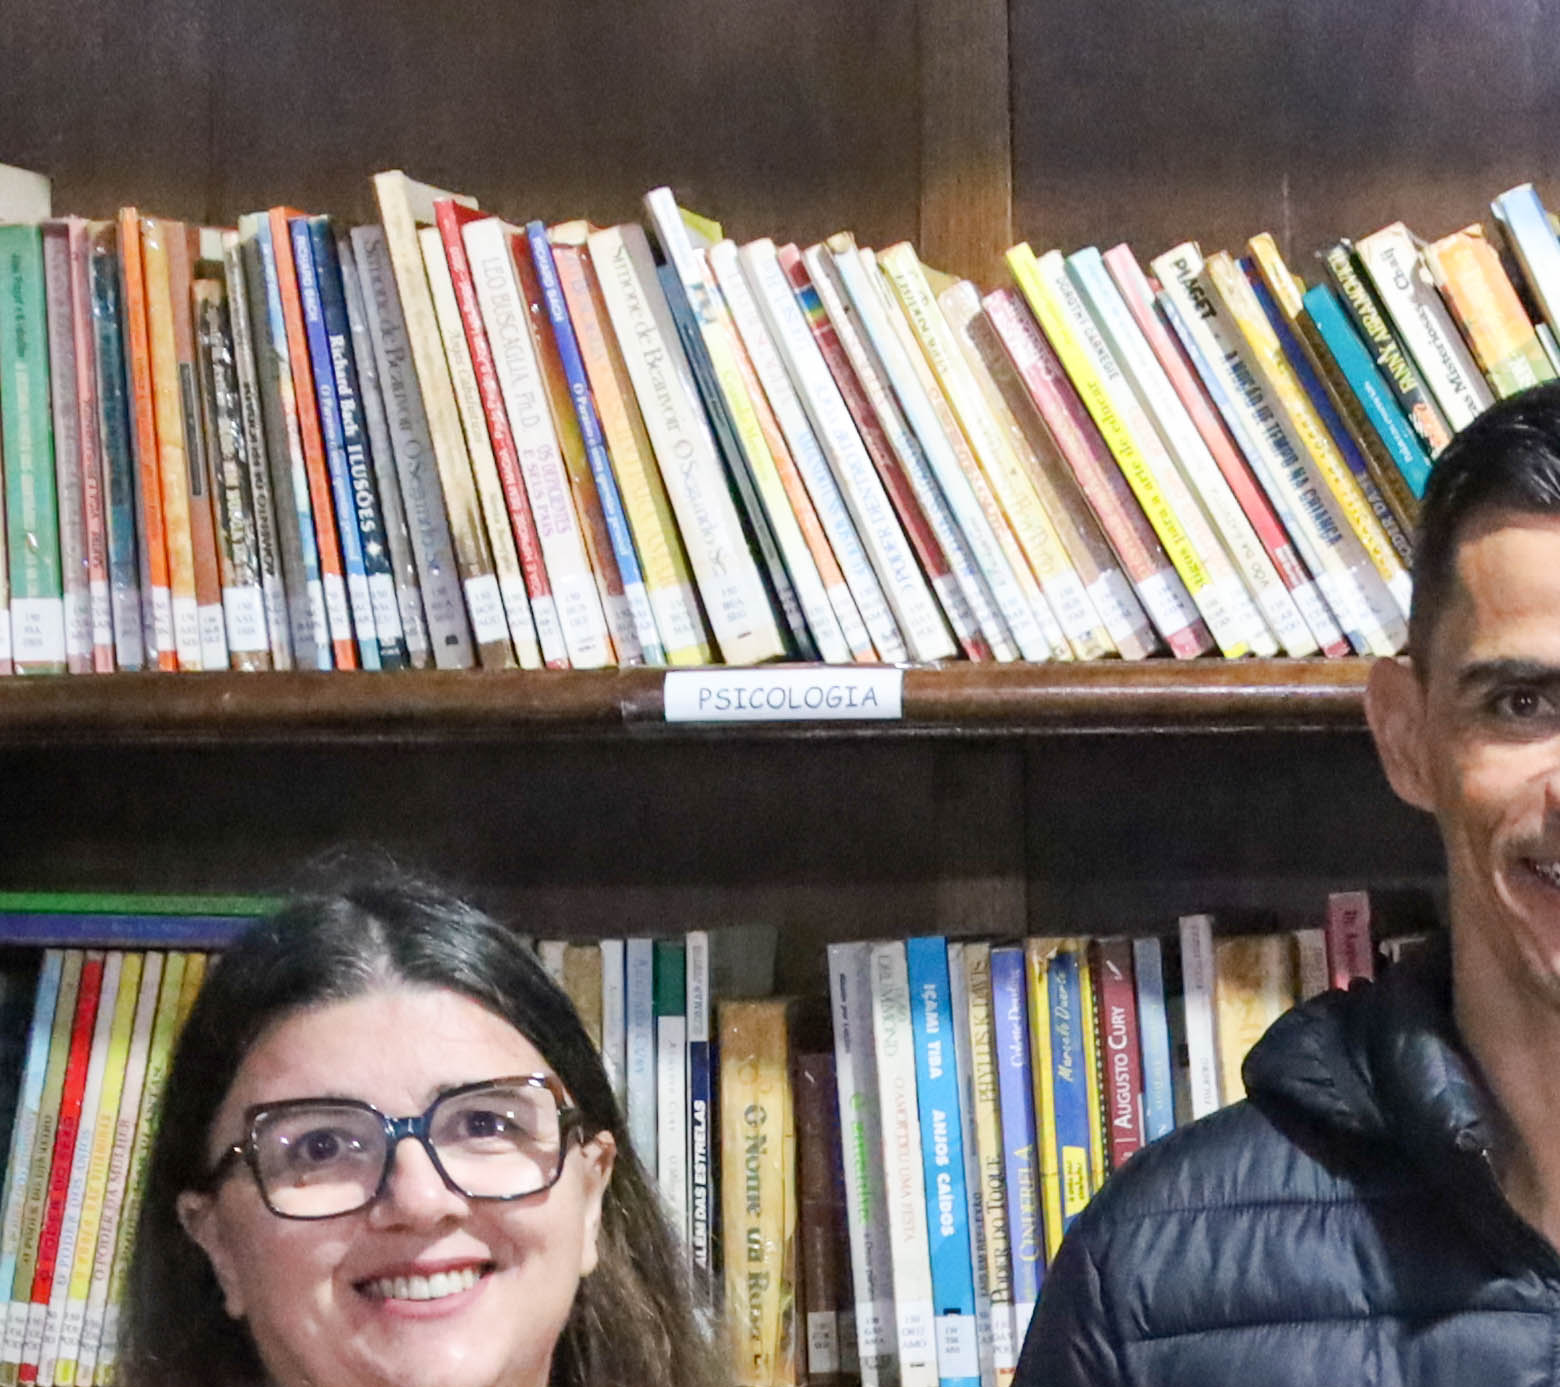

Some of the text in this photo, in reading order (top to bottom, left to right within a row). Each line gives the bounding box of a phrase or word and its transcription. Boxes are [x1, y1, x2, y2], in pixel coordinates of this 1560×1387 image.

[545, 287, 565, 323] BACH
[1170, 255, 1217, 322] PIAGET
[327, 333, 379, 533] Richard ILUSÕES
[1082, 380, 1122, 436] educar
[698, 686, 878, 712] PSICOLOGIA
[1053, 968, 1072, 1018] Duarte
[1109, 1005, 1134, 1128] AUGUSTO CURY
[920, 982, 959, 1237] IÇAMI TIBA ANJOS CAÍDOS
[690, 1099, 711, 1269] ALÉM DAS ESTRELAS
[741, 1135, 771, 1217] Nome
[986, 1246, 1012, 1305] PODER
